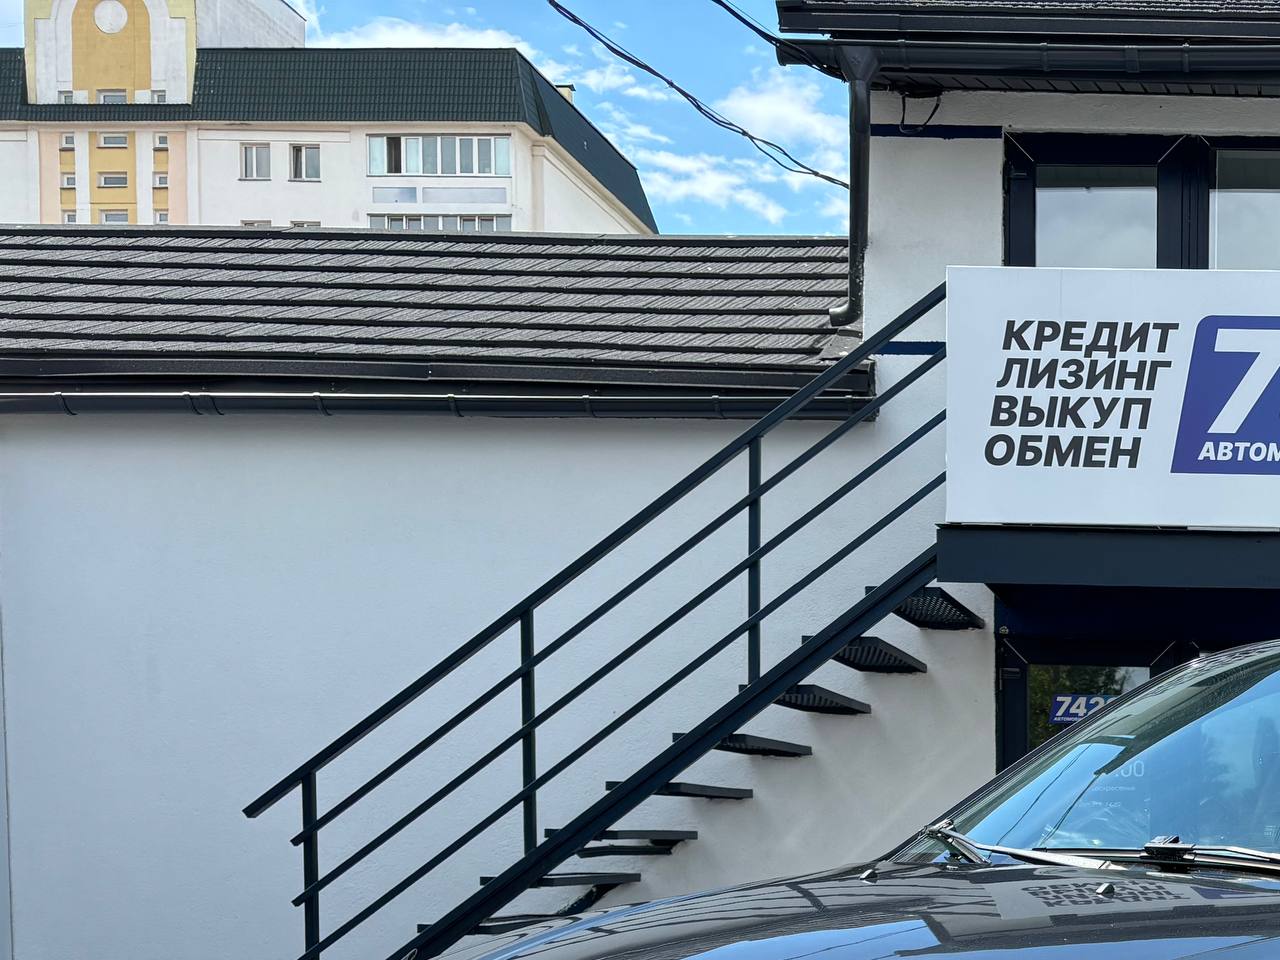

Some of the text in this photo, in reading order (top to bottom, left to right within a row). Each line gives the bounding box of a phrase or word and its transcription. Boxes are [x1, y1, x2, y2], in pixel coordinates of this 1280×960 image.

[1002, 319, 1180, 358] КРЕДИТ
[996, 357, 1173, 391] ЛИЗИНГ
[990, 394, 1152, 430] ВЫКУП
[984, 433, 1142, 469] ОБМЕН
